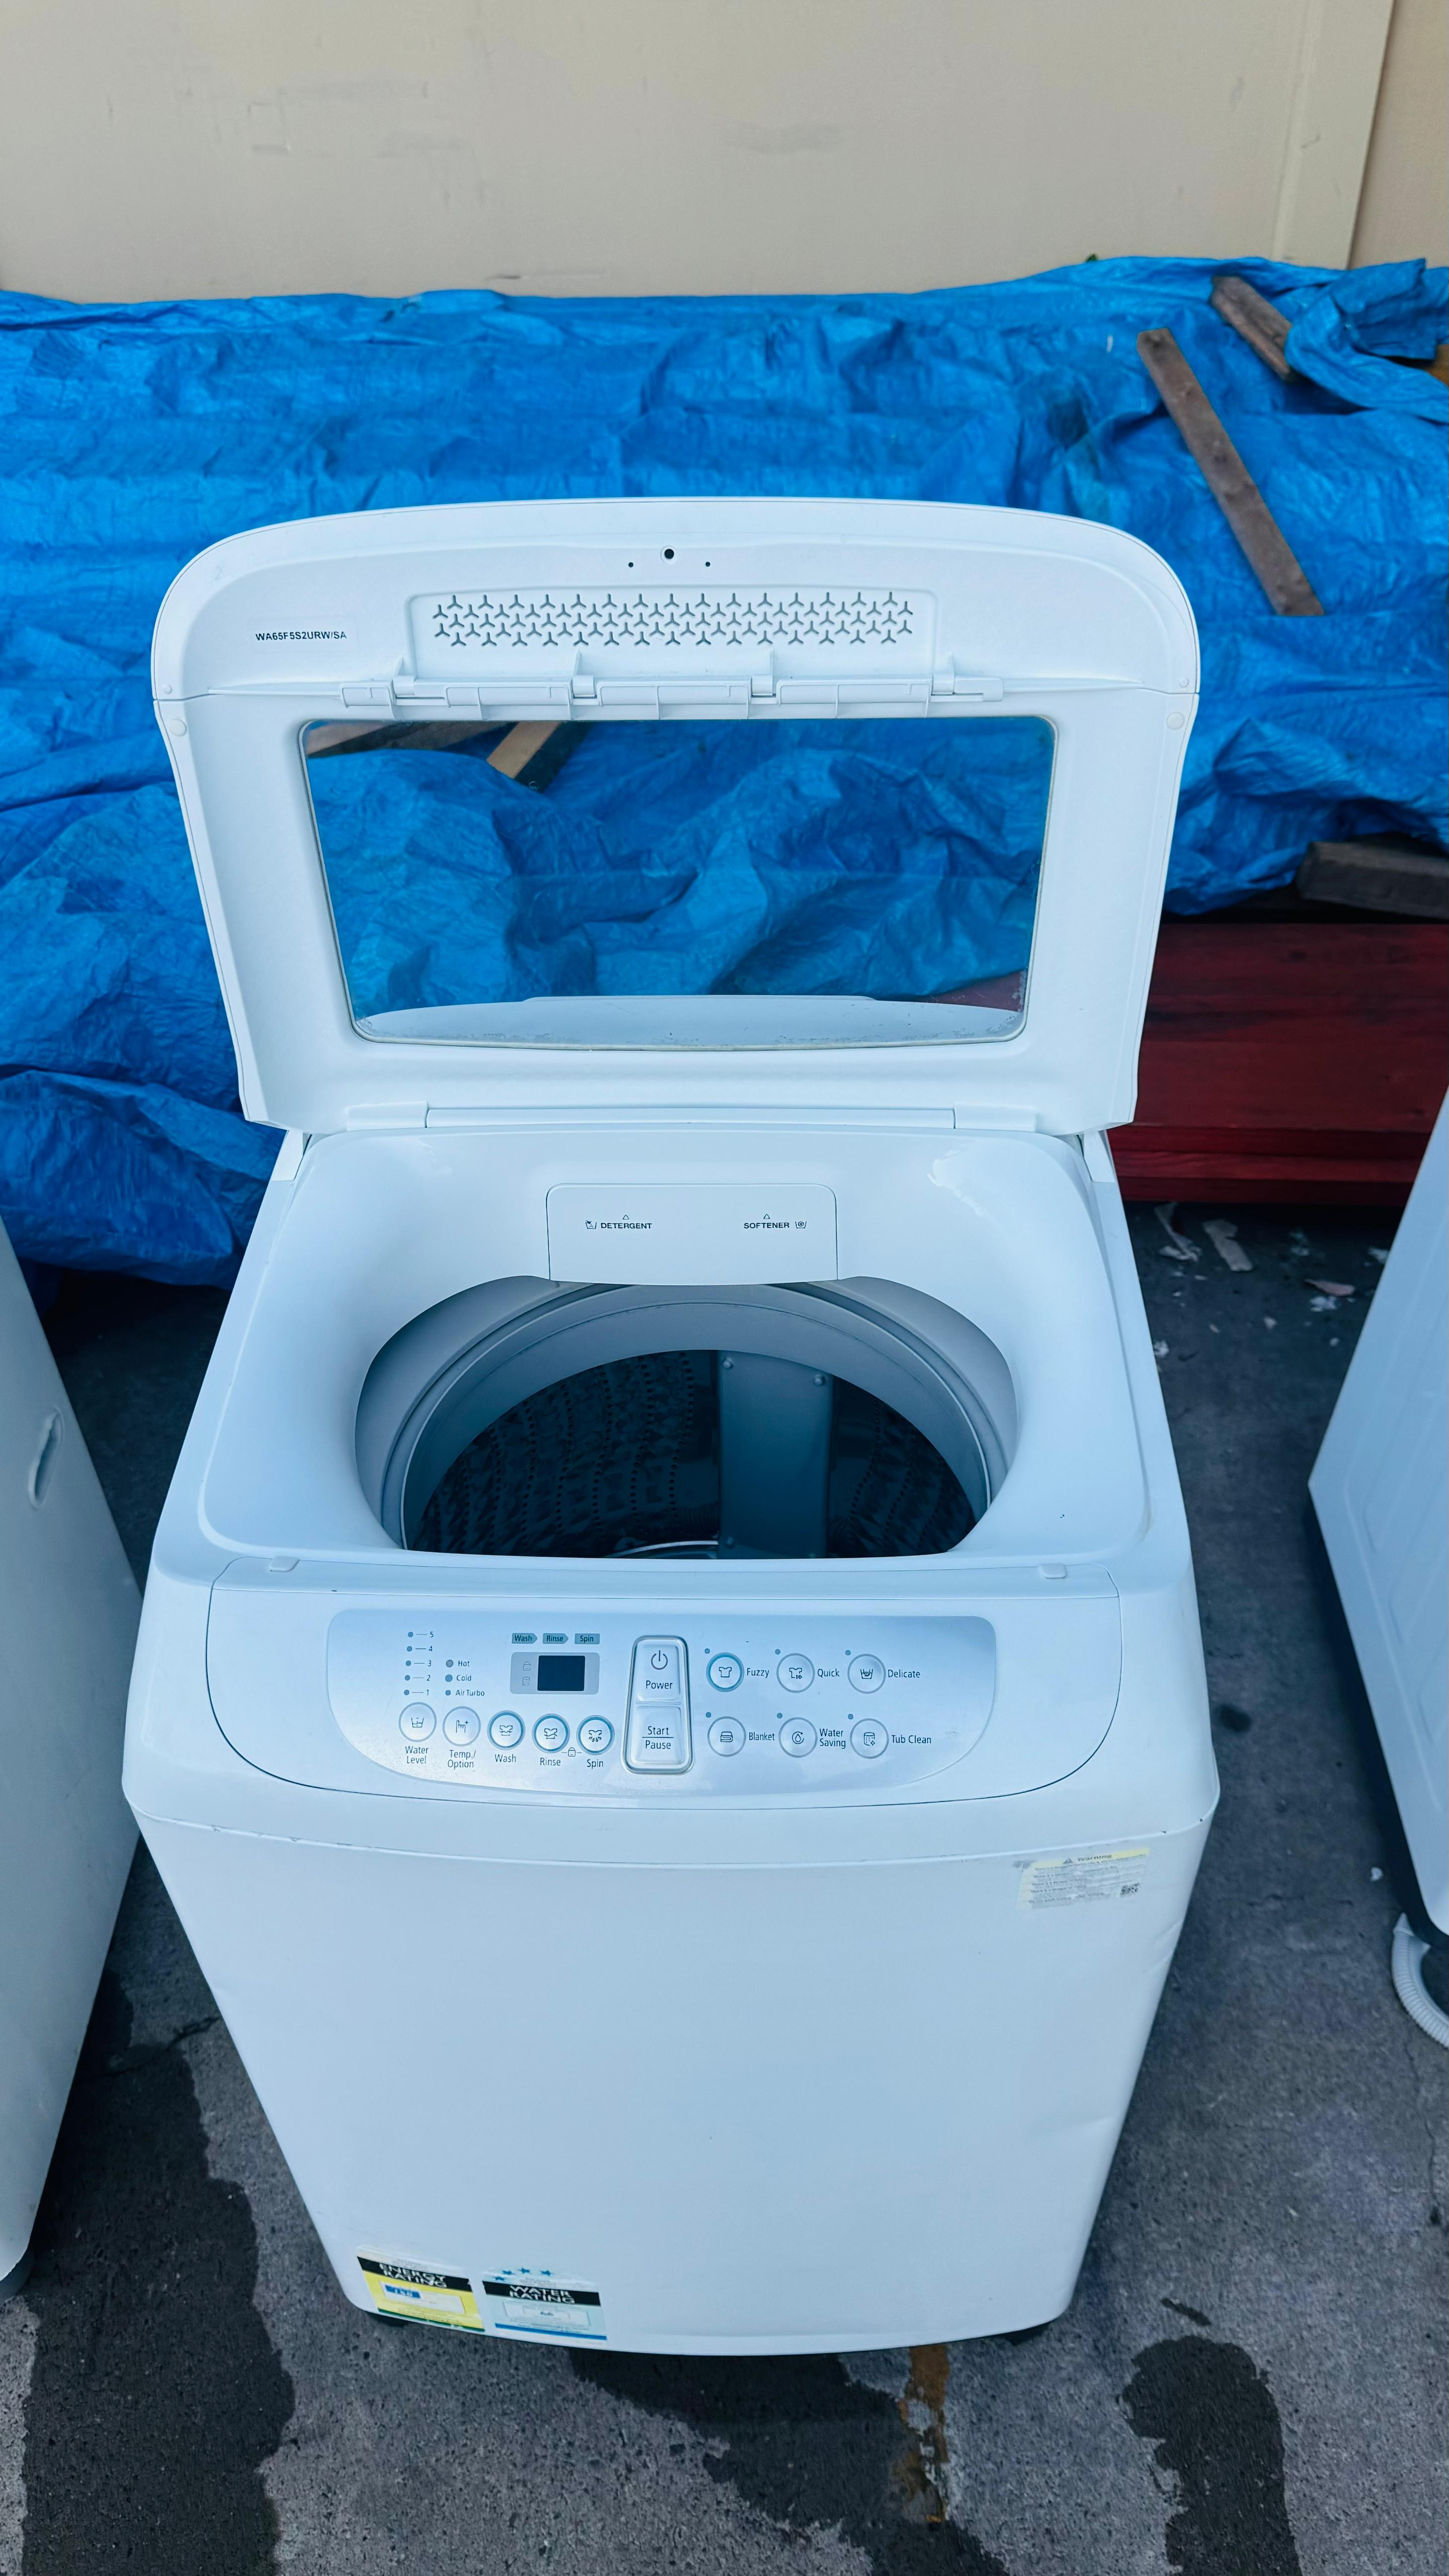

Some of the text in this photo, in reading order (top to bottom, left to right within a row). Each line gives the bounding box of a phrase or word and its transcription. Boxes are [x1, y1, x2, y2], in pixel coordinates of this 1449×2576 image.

[256, 631, 347, 640] WA65F5S2URW/SA
[580, 1635, 594, 1643] Spin
[747, 1668, 769, 1678] Fuzzy
[818, 1668, 840, 1677] Quick
[888, 1669, 920, 1678] Delicate
[646, 1680, 673, 1689] Power
[648, 1726, 669, 1735] Start
[820, 1728, 844, 1737] Water
[749, 1732, 775, 1741] Blanket
[892, 1735, 931, 1744] Tub Clean
[645, 1741, 671, 1750] Pause
[820, 1738, 846, 1749] Saving
[405, 1746, 428, 1754] Water
[449, 1749, 476, 1760] Temp./
[407, 1755, 427, 1764] Level
[495, 1754, 516, 1762] Wash
[540, 1757, 560, 1766] Rinse
[448, 1759, 474, 1769] Option
[587, 1759, 604, 1768] Spin
[379, 2263, 446, 2282] ENERGY
[383, 2270, 447, 2288] RATING
[510, 2285, 571, 2298] WATER
[510, 2291, 575, 2304] RATING
